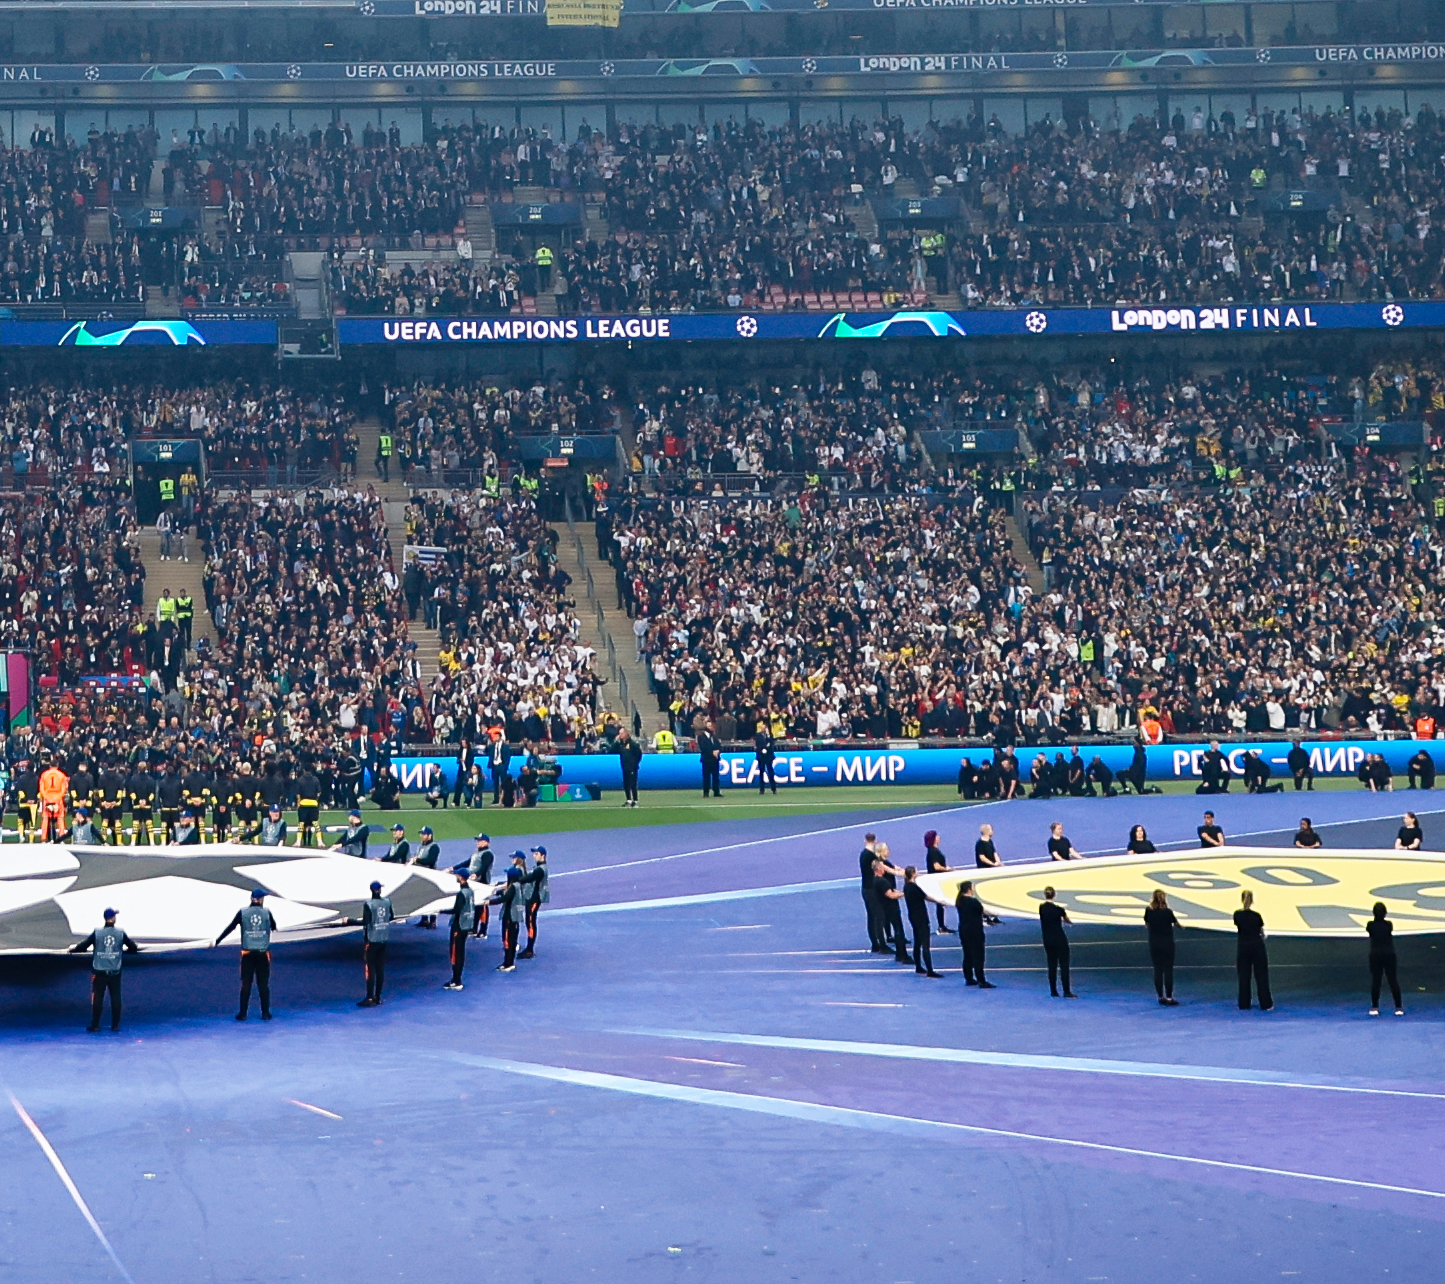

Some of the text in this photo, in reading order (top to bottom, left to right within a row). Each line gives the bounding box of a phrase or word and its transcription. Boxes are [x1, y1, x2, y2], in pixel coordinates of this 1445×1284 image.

[480, 0, 501, 16] 24
[1315, 47, 1359, 62] UEFA
[345, 63, 556, 79] UEFA CHAMPIONS LEAGUE
[924, 56, 945, 72] 24
[951, 55, 1009, 70] FINAL
[1199, 308, 1230, 330] 24
[1236, 308, 1317, 329] FINAL
[384, 318, 670, 341] UEFA CHAMPIONS LEAGUE
